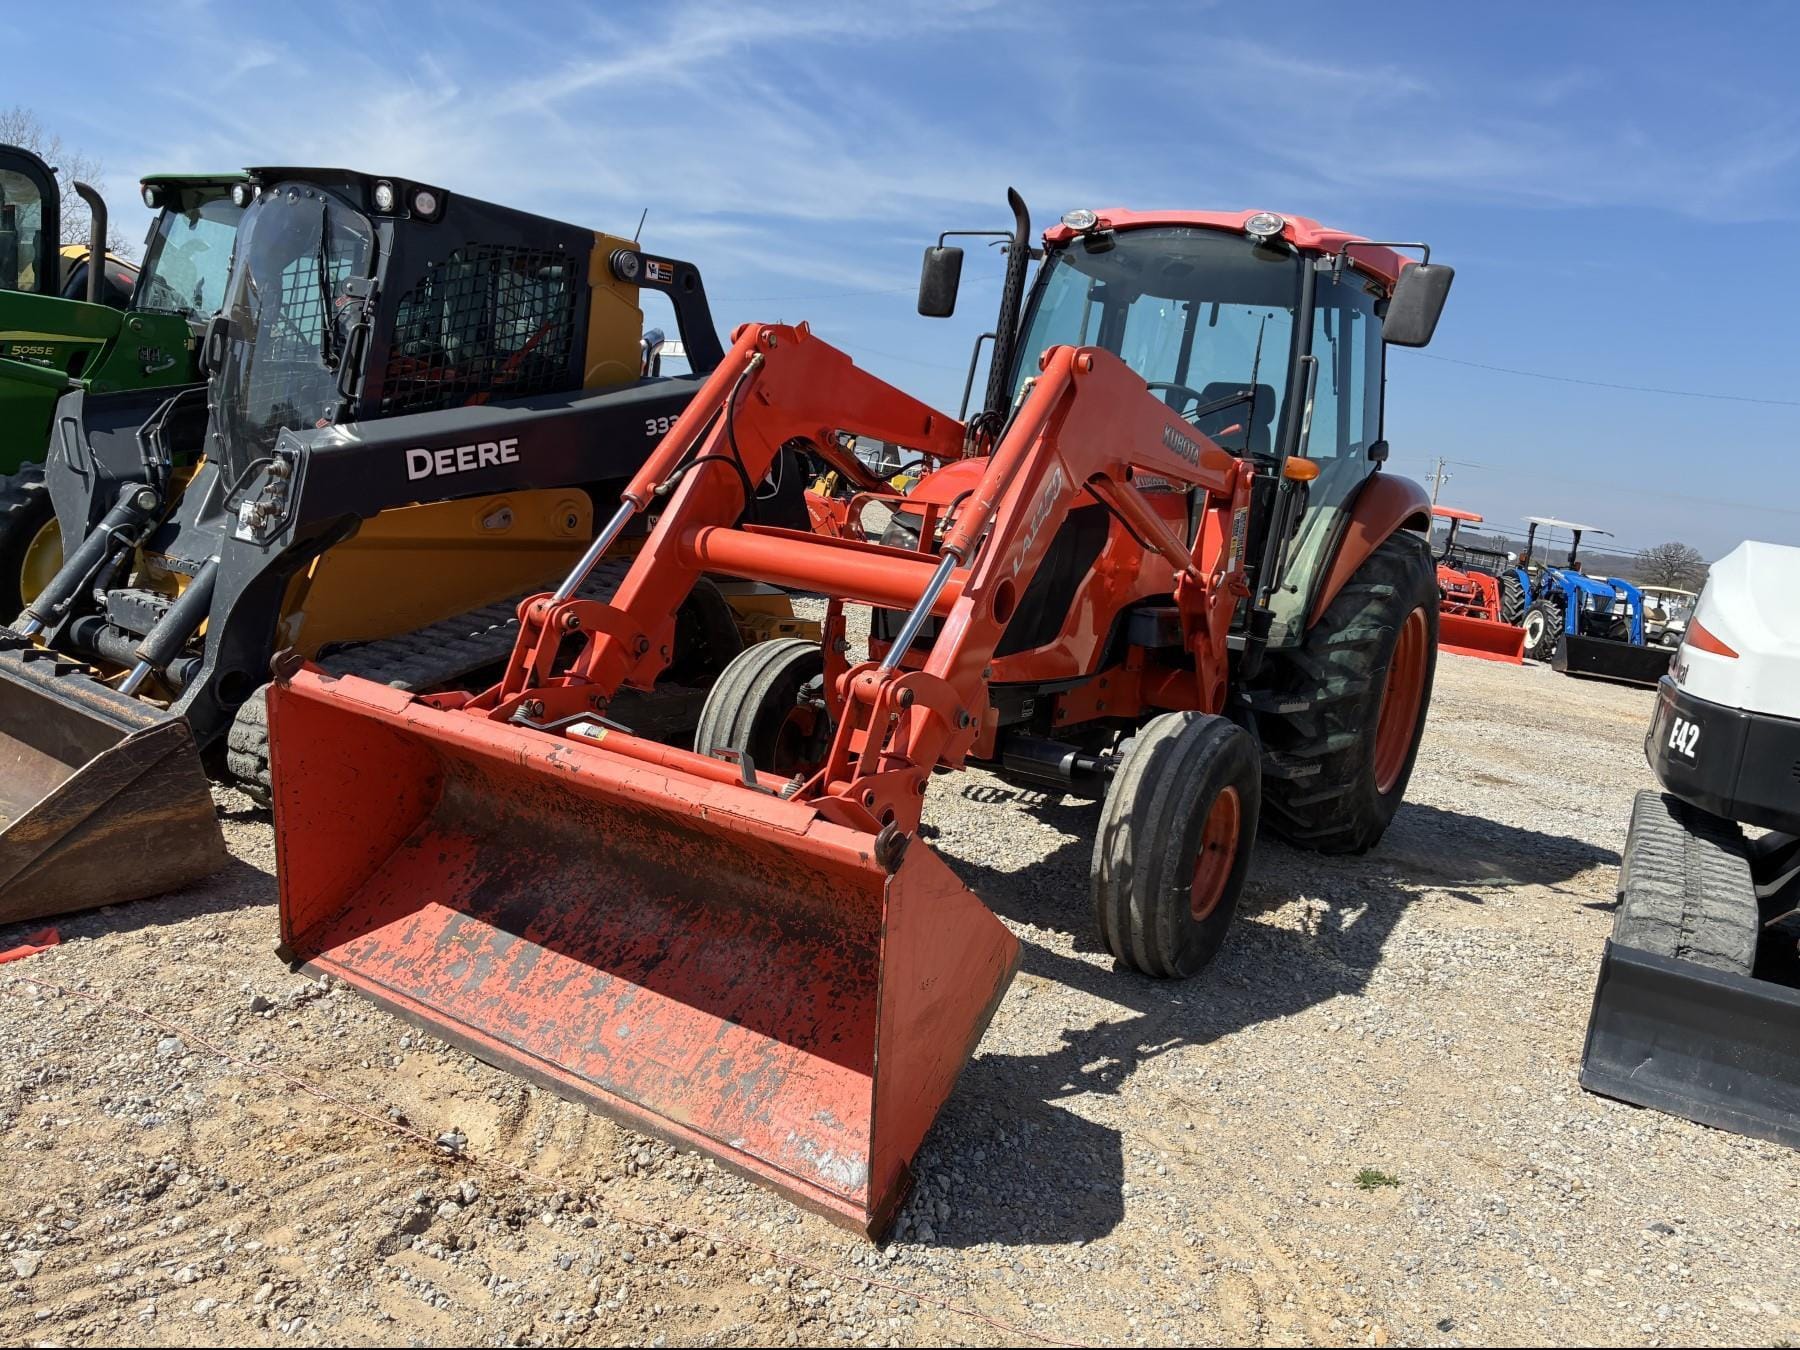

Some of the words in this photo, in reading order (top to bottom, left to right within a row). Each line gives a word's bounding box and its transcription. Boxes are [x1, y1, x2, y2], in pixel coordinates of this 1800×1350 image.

[11, 345, 55, 355] 5055E
[405, 438, 520, 480] DEERE
[1162, 423, 1200, 466] KUBOTA
[1668, 717, 1700, 759] E42
